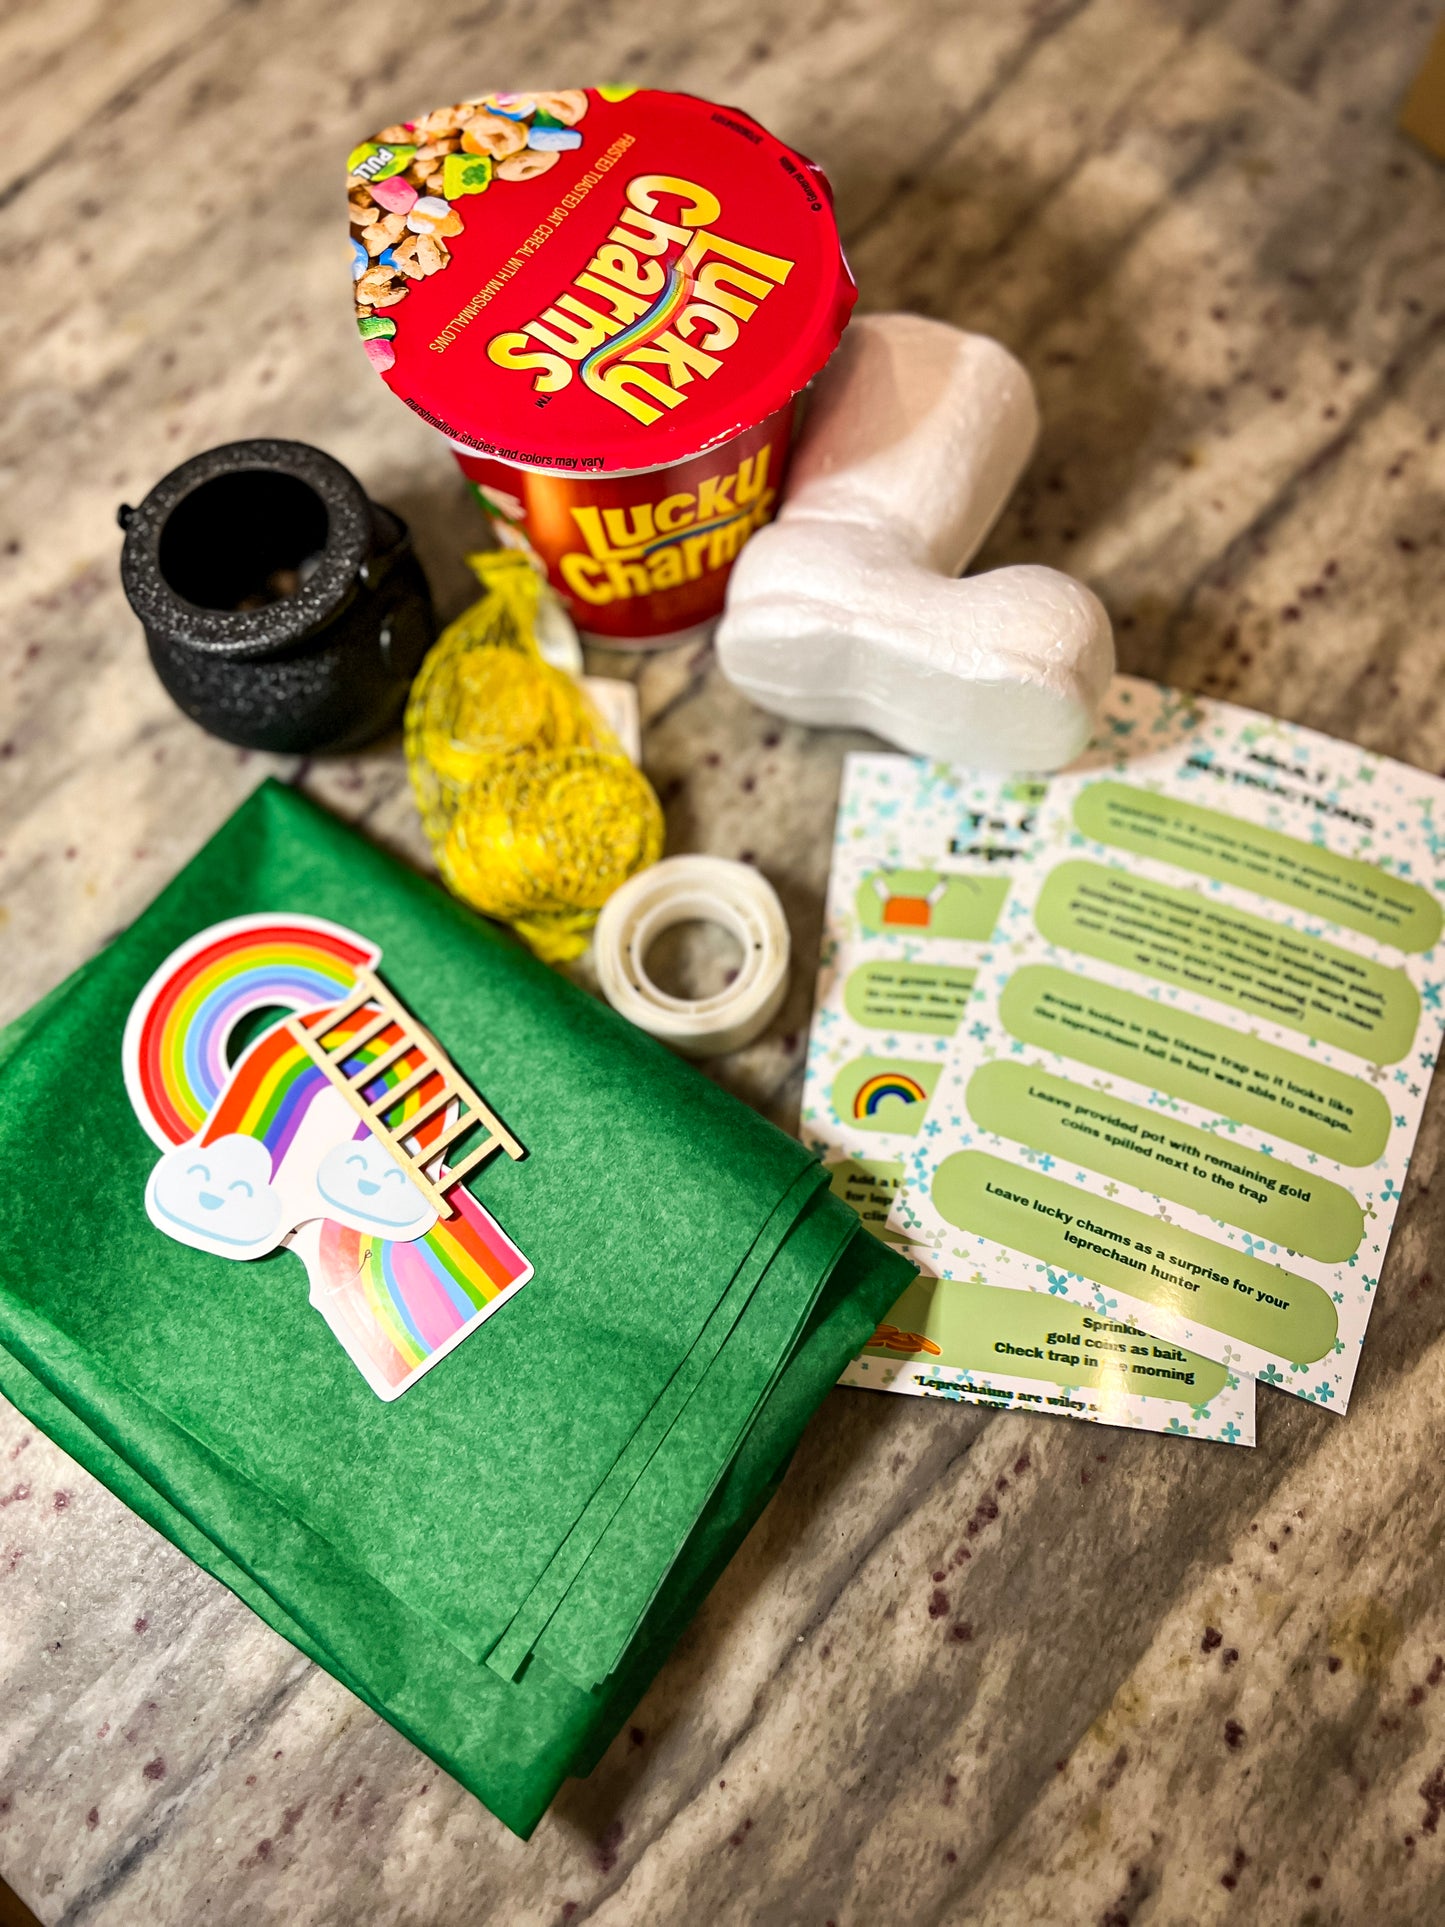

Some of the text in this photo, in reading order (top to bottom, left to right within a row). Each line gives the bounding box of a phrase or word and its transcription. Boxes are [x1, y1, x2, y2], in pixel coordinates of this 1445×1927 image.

[352, 146, 395, 180] PULL
[429, 132, 636, 353] FROSTED TOASTED OAT CEREAL WITH MARSHMALLOWS
[487, 174, 721, 393] Charms
[580, 228, 795, 427] Lucky
[403, 397, 605, 470] marshmallow shapes and colors may vary
[571, 443, 772, 561] Lucky
[1214, 1073, 1242, 1088] was
[1246, 1085, 1276, 1101] able
[1281, 1097, 1294, 1108] to
[1298, 1106, 1352, 1133] escape.
[1221, 1056, 1249, 1074] trap
[1254, 1070, 1269, 1080] so
[1287, 1081, 1324, 1103] looks
[1328, 1098, 1353, 1115] like
[1028, 1087, 1311, 1202] Leave provided pot with remaining gold
[1059, 1115, 1268, 1204] coins spilled next to the trap
[985, 1182, 1290, 1310] Leave lucky charms as a surprise for your
[1064, 1230, 1200, 1292] leprechaun hunter
[994, 1342, 1043, 1359] Check
[1048, 1350, 1080, 1366] trap
[1084, 1354, 1098, 1367] in
[1132, 1365, 1195, 1385] morning
[1046, 1332, 1080, 1345] gold
[1130, 1346, 1149, 1356] as
[1153, 1346, 1189, 1362] bait.
[1017, 1393, 1042, 1403] are
[1046, 1395, 1086, 1411] wiley
